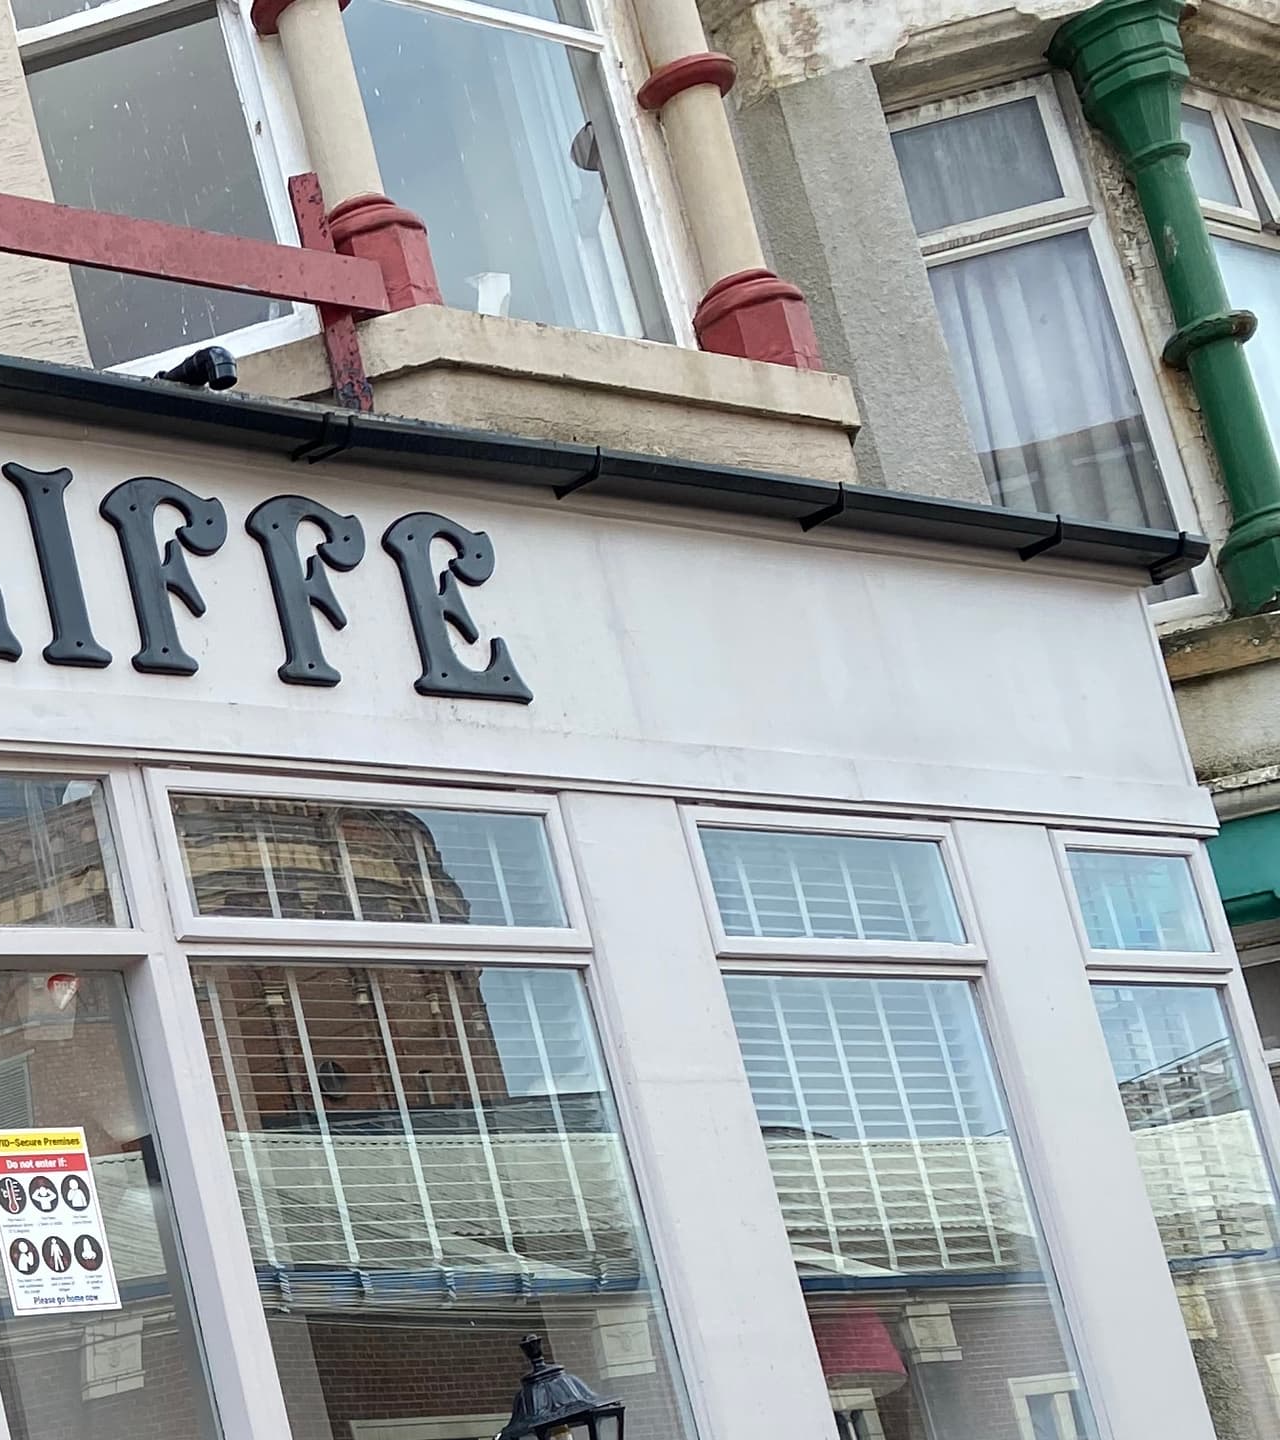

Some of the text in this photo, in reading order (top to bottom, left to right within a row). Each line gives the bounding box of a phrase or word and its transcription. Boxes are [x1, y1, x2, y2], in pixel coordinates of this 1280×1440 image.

[43, 1137, 81, 1147] Premises
[5, 1159, 18, 1170] Do
[19, 1159, 34, 1169] not
[34, 1158, 57, 1168] enter
[33, 1293, 99, 1305] Please go home now
